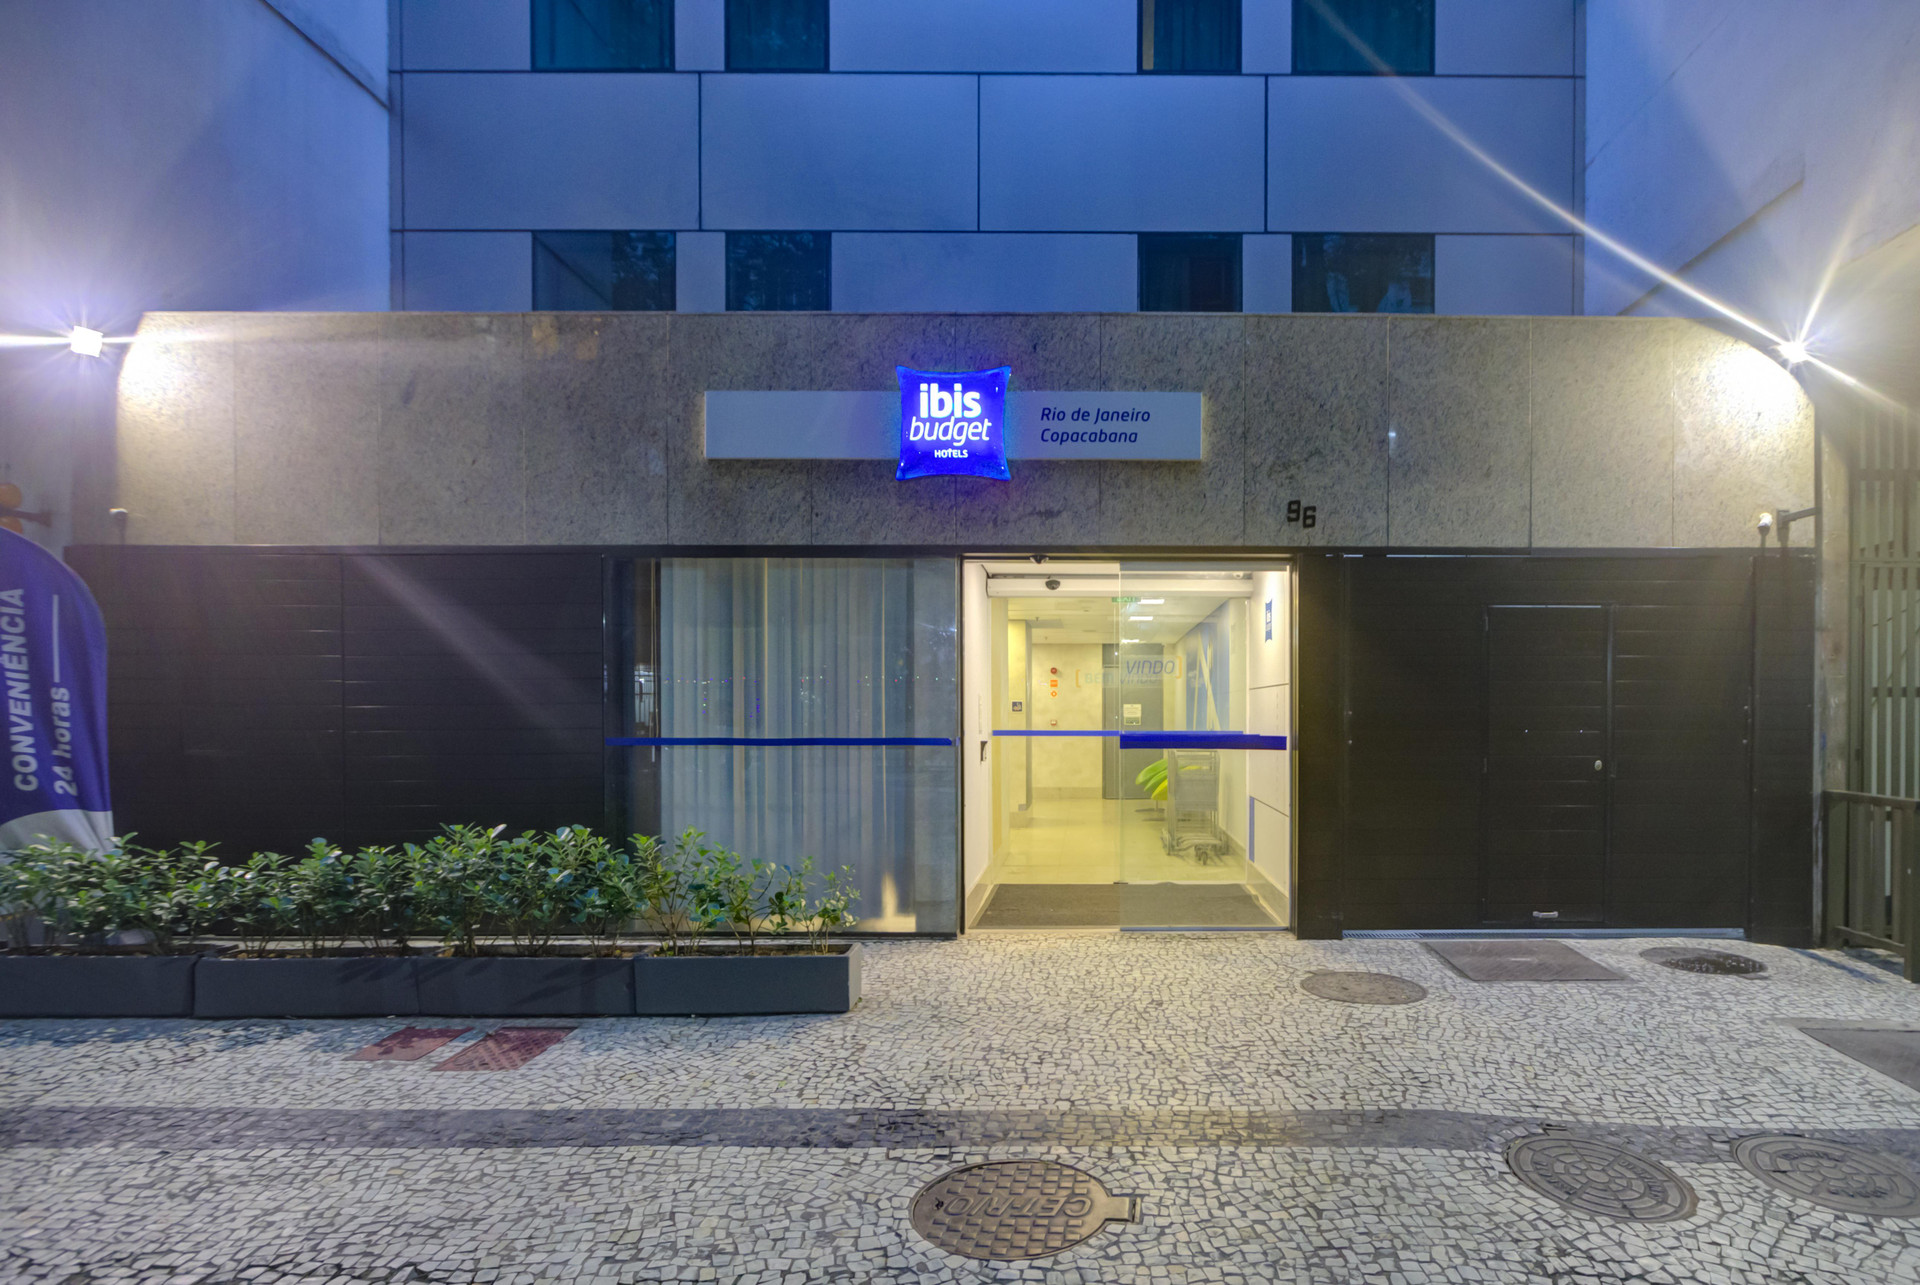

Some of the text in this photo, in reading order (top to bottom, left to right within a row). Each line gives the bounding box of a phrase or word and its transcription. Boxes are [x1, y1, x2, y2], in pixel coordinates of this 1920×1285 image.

[920, 383, 982, 418] ibis
[1041, 407, 1151, 425] Rio de Janeiro
[909, 416, 992, 447] budget
[1040, 428, 1138, 445] Copacabana
[933, 448, 969, 458] HOTELS
[1287, 499, 1316, 528] 96
[51, 687, 78, 797] 24 horas
[946, 1196, 1092, 1217] CET-RIO
